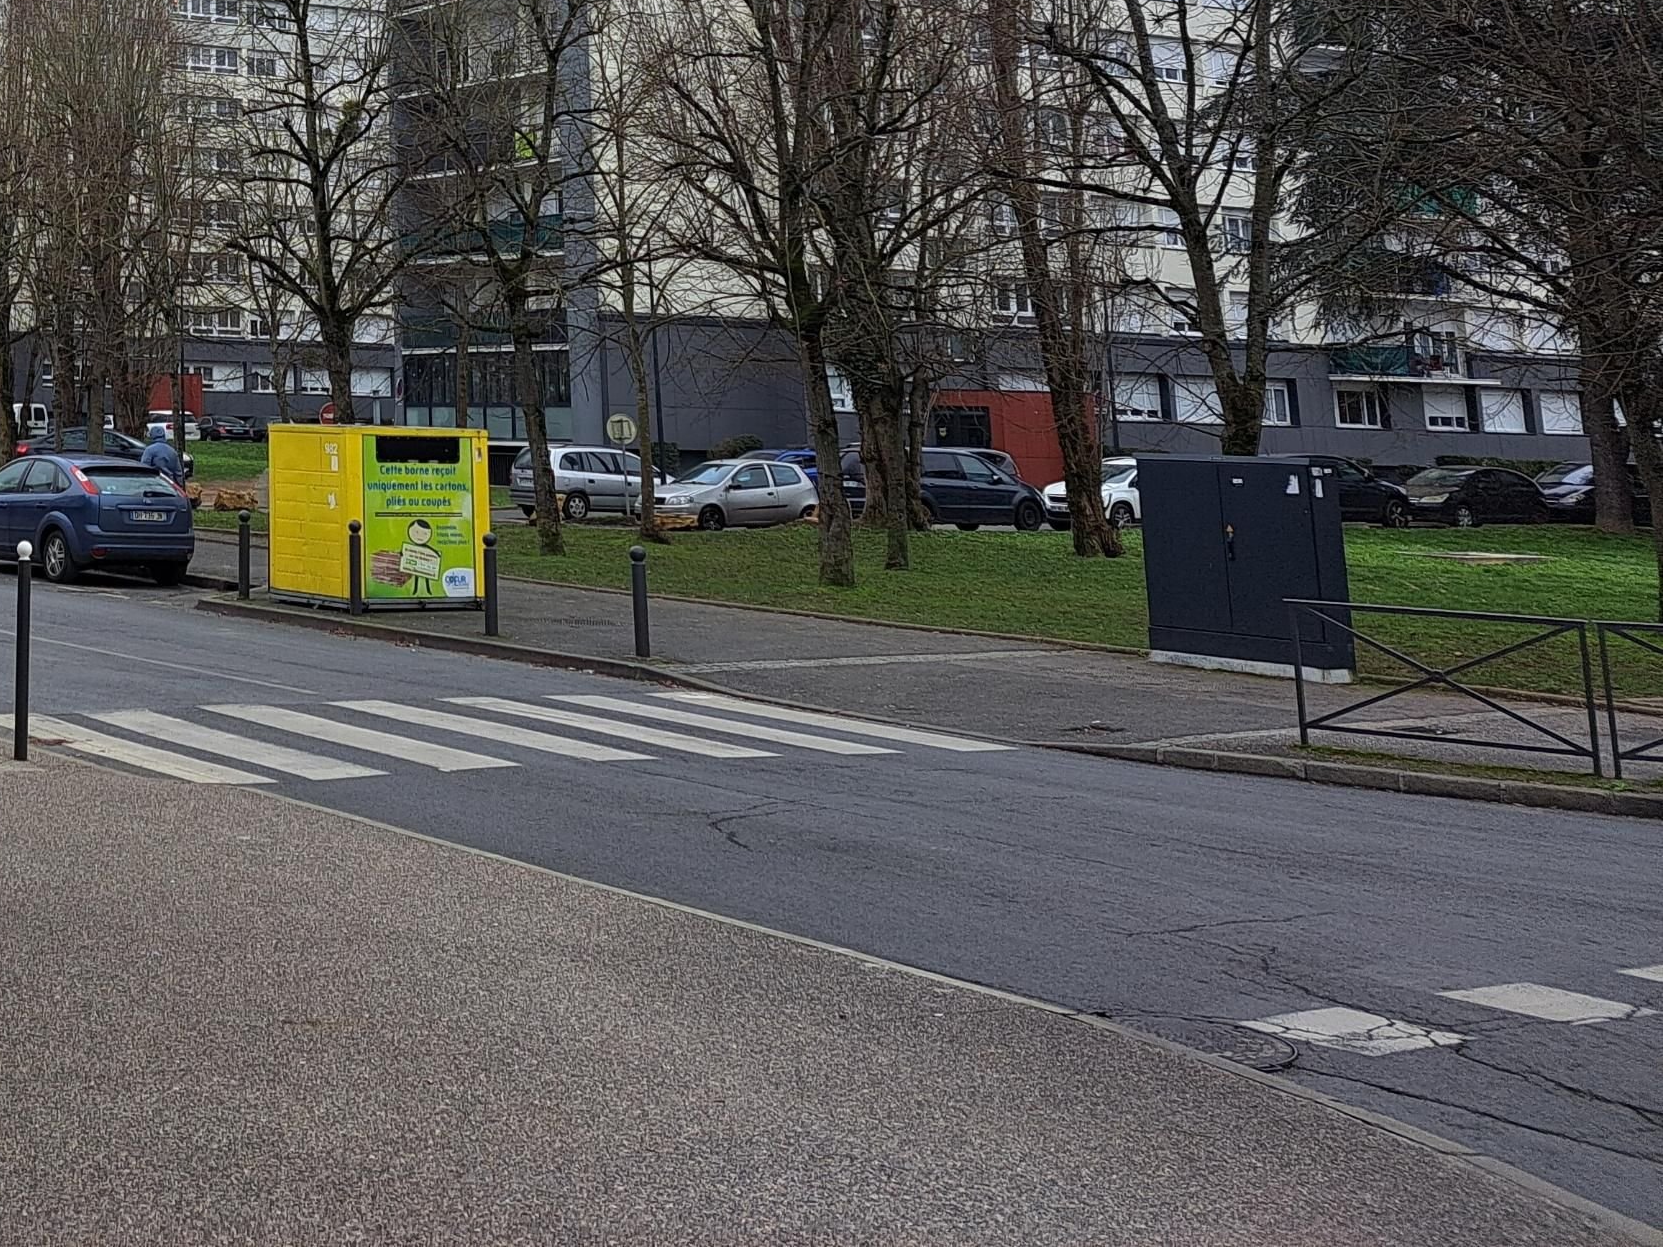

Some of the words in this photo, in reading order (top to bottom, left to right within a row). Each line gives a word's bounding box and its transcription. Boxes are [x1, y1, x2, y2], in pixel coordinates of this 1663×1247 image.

[380, 465, 402, 475] Cette
[405, 465, 429, 475] borne
[432, 466, 456, 478] reçoit
[367, 481, 418, 493] uniquement
[421, 481, 433, 491] les
[386, 495, 407, 509] pliés
[409, 497, 419, 507] ou
[421, 496, 451, 509] coupés
